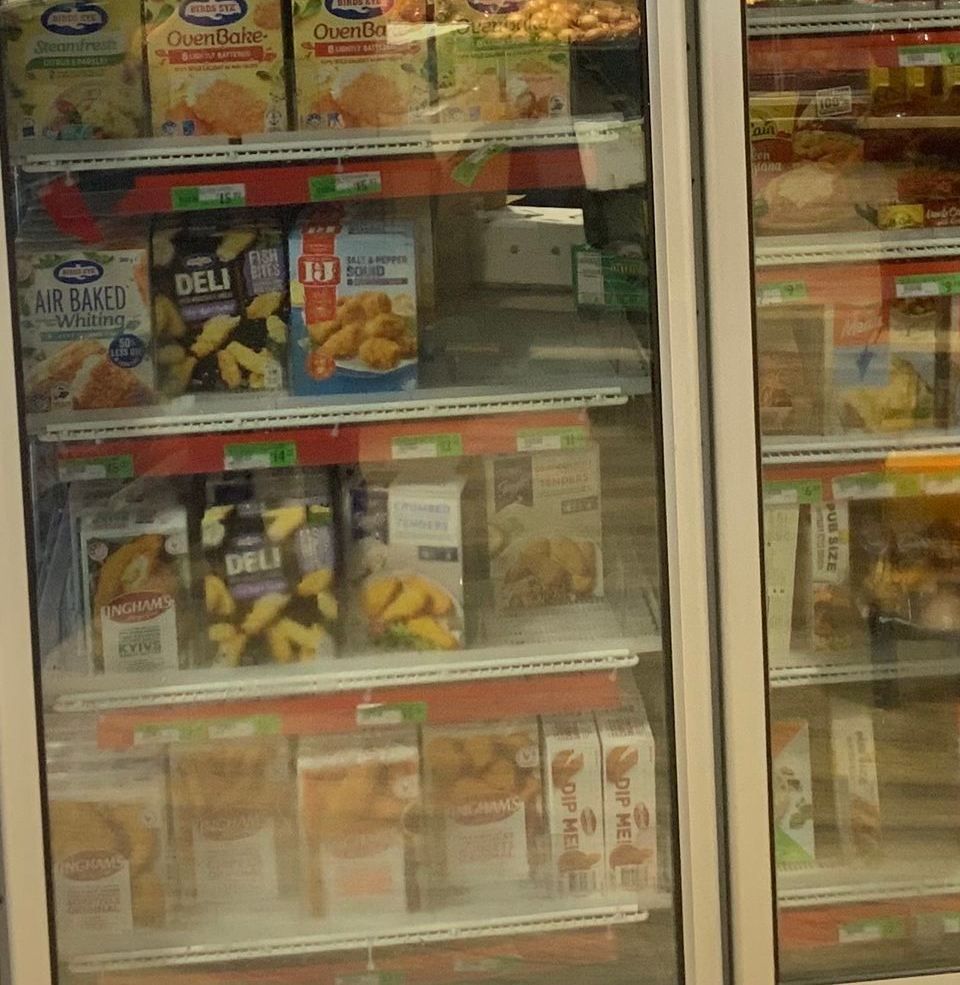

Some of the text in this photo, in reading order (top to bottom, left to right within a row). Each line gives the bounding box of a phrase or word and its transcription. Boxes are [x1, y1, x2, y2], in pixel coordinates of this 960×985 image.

[190, 4, 216, 14] BIRDS
[167, 26, 264, 47] OvenBake
[314, 21, 392, 40] OvenBa
[34, 39, 117, 55] Steamfresh
[249, 248, 279, 266] FISH
[174, 268, 231, 297] DELI
[35, 285, 127, 314] AIR BAKED
[56, 313, 126, 330] Whiting
[826, 503, 839, 572] PUB SIZE
[225, 547, 281, 575] DELI
[561, 782, 579, 850] DIP ME!
[615, 777, 632, 844] DIP ME!
